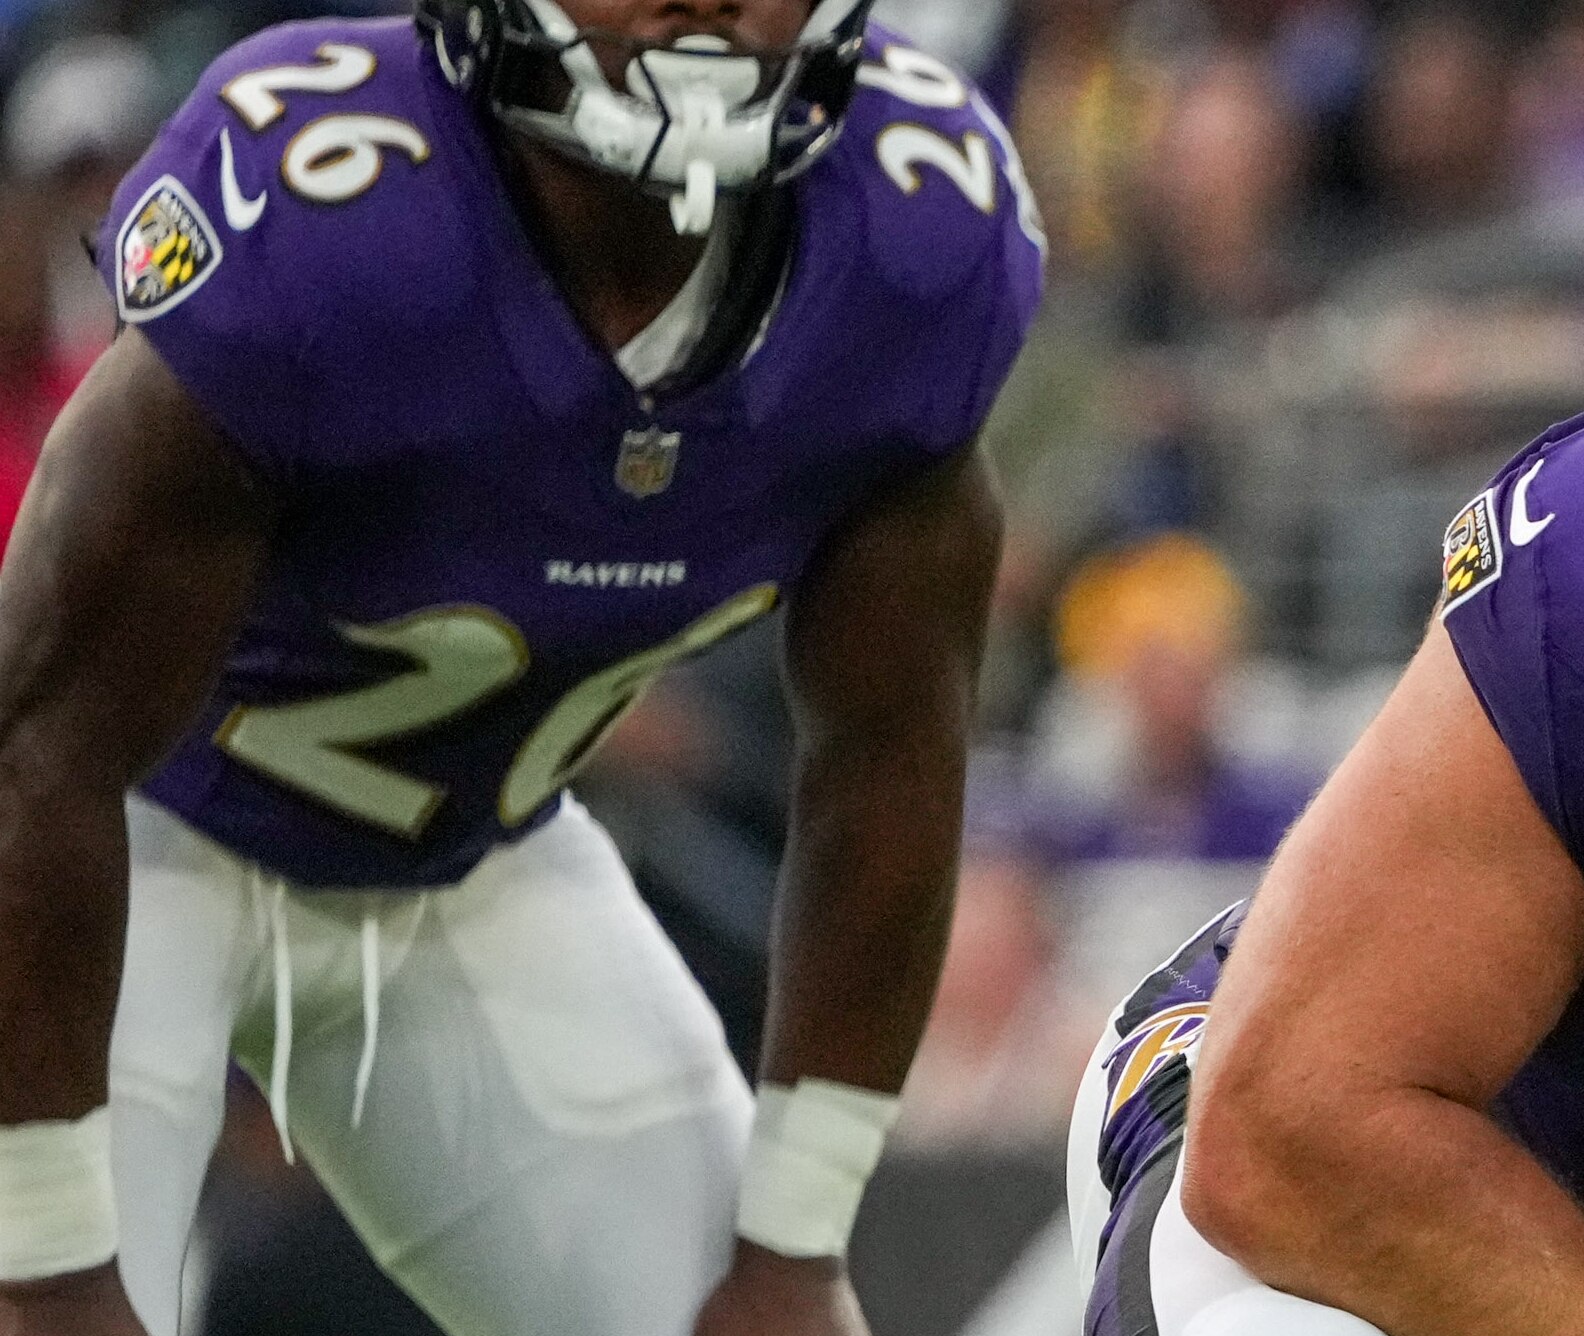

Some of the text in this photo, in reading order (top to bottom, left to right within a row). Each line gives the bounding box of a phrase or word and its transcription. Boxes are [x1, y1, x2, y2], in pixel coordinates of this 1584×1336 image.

[219, 42, 430, 204] 26
[855, 45, 995, 215] 26
[544, 560, 686, 589] RAVENS
